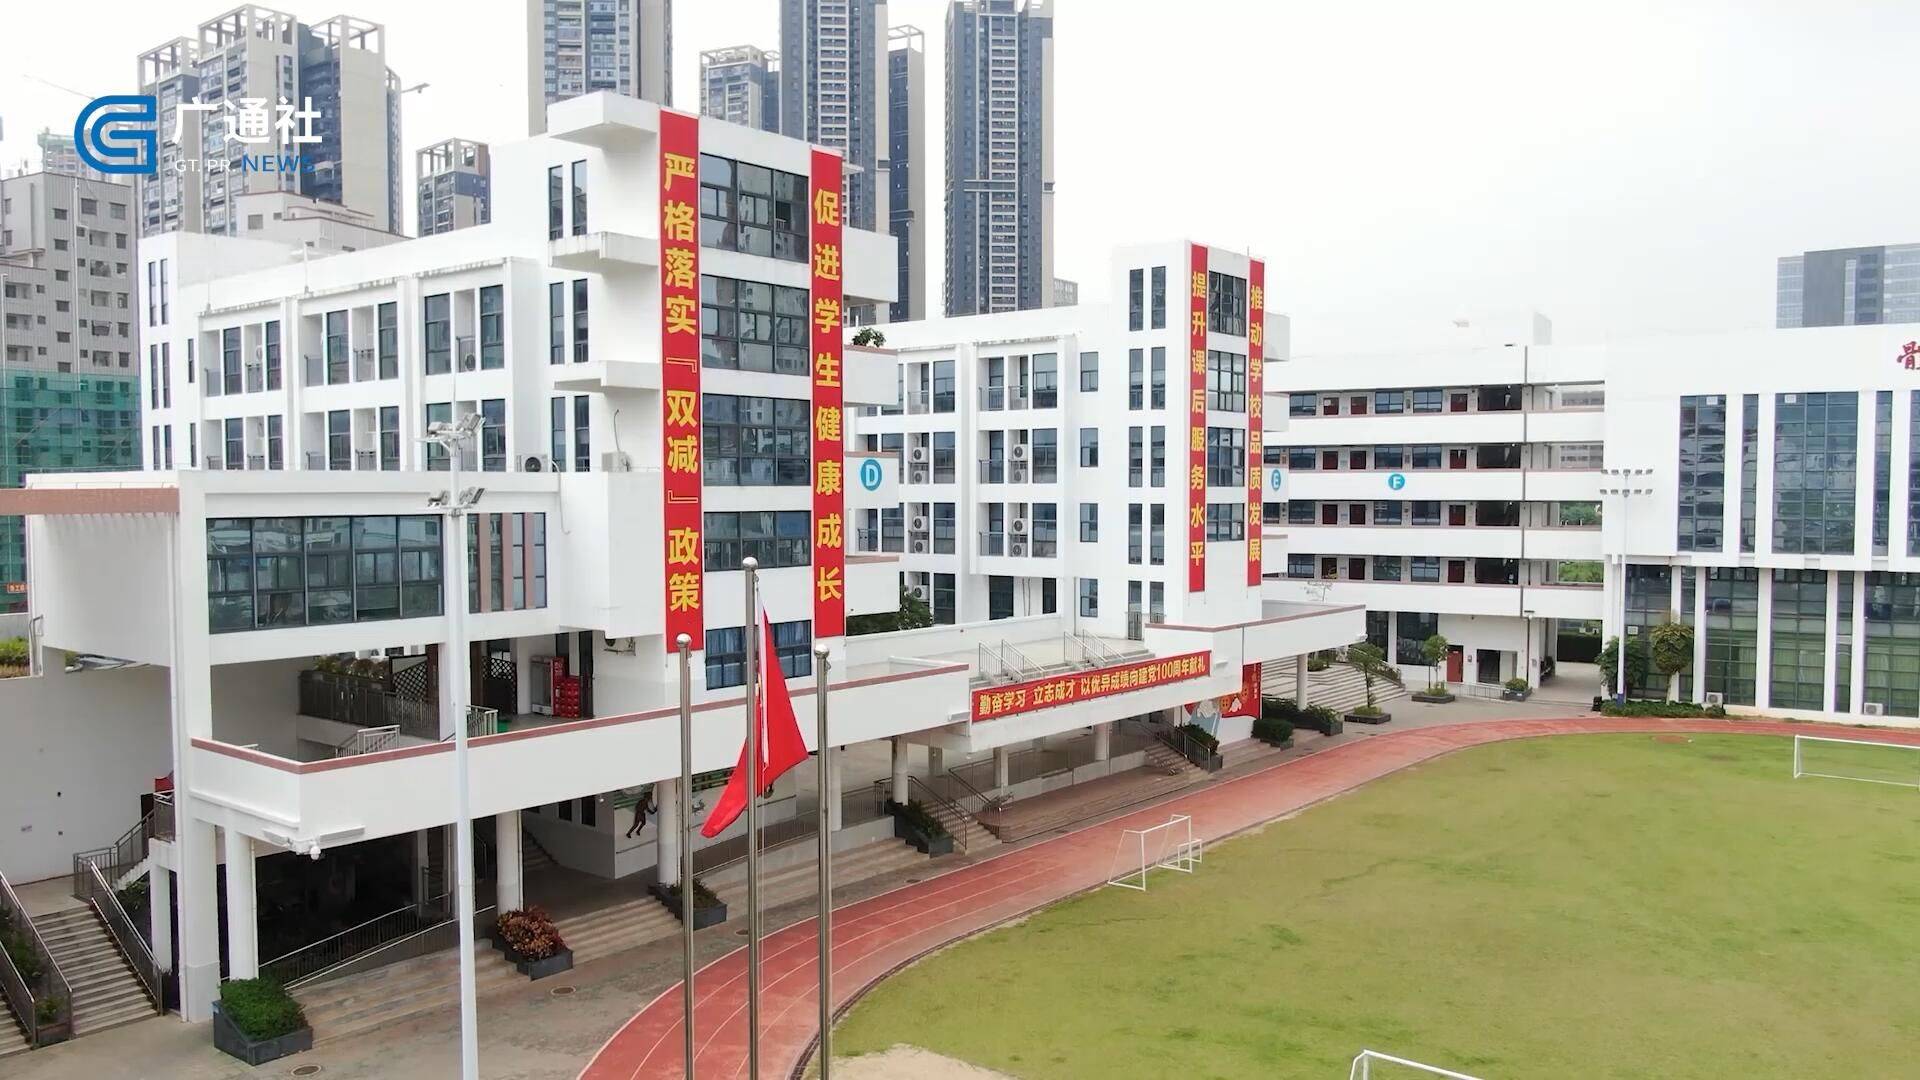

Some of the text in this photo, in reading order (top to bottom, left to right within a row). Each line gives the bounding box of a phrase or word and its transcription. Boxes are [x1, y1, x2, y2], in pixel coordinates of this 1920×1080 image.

[814, 188, 842, 603] 促进学生健康成长
[865, 464, 879, 487] D
[1191, 271, 1206, 566] 提升课后服务水平
[1249, 286, 1263, 562] 推动学校品质发展
[979, 689, 1026, 715] 勤奋学习
[1033, 680, 1076, 705] 立志成才
